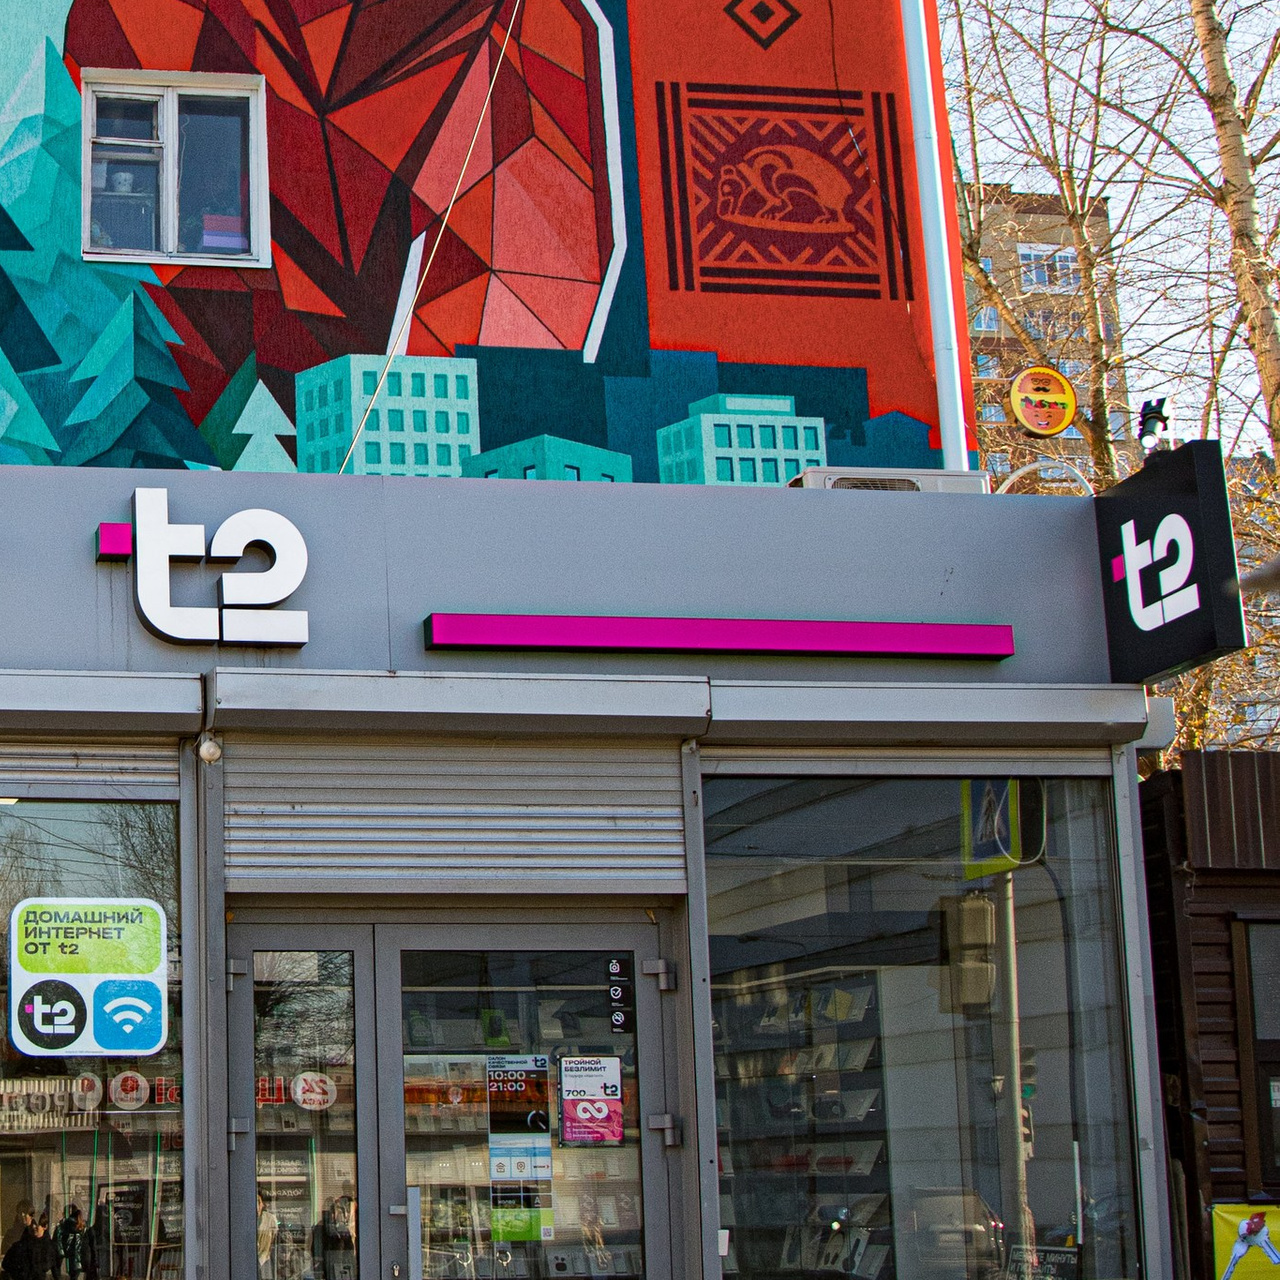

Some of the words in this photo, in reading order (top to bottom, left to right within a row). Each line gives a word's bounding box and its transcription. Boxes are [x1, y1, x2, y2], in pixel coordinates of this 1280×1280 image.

[128, 487, 310, 648] t2
[1119, 512, 1201, 632] t2
[23, 908, 144, 925] ДОМАШНИЙ
[24, 926, 126, 940] ИНТЕРНЕТ
[24, 941, 51, 955] ОТ
[58, 941, 80, 955] t2
[32, 995, 77, 1035] t2
[564, 1058, 601, 1066] ТРОЙНОЙ
[488, 1070, 526, 1080] 10:00
[489, 1081, 526, 1091] 21:00
[565, 1089, 587, 1097] 700
